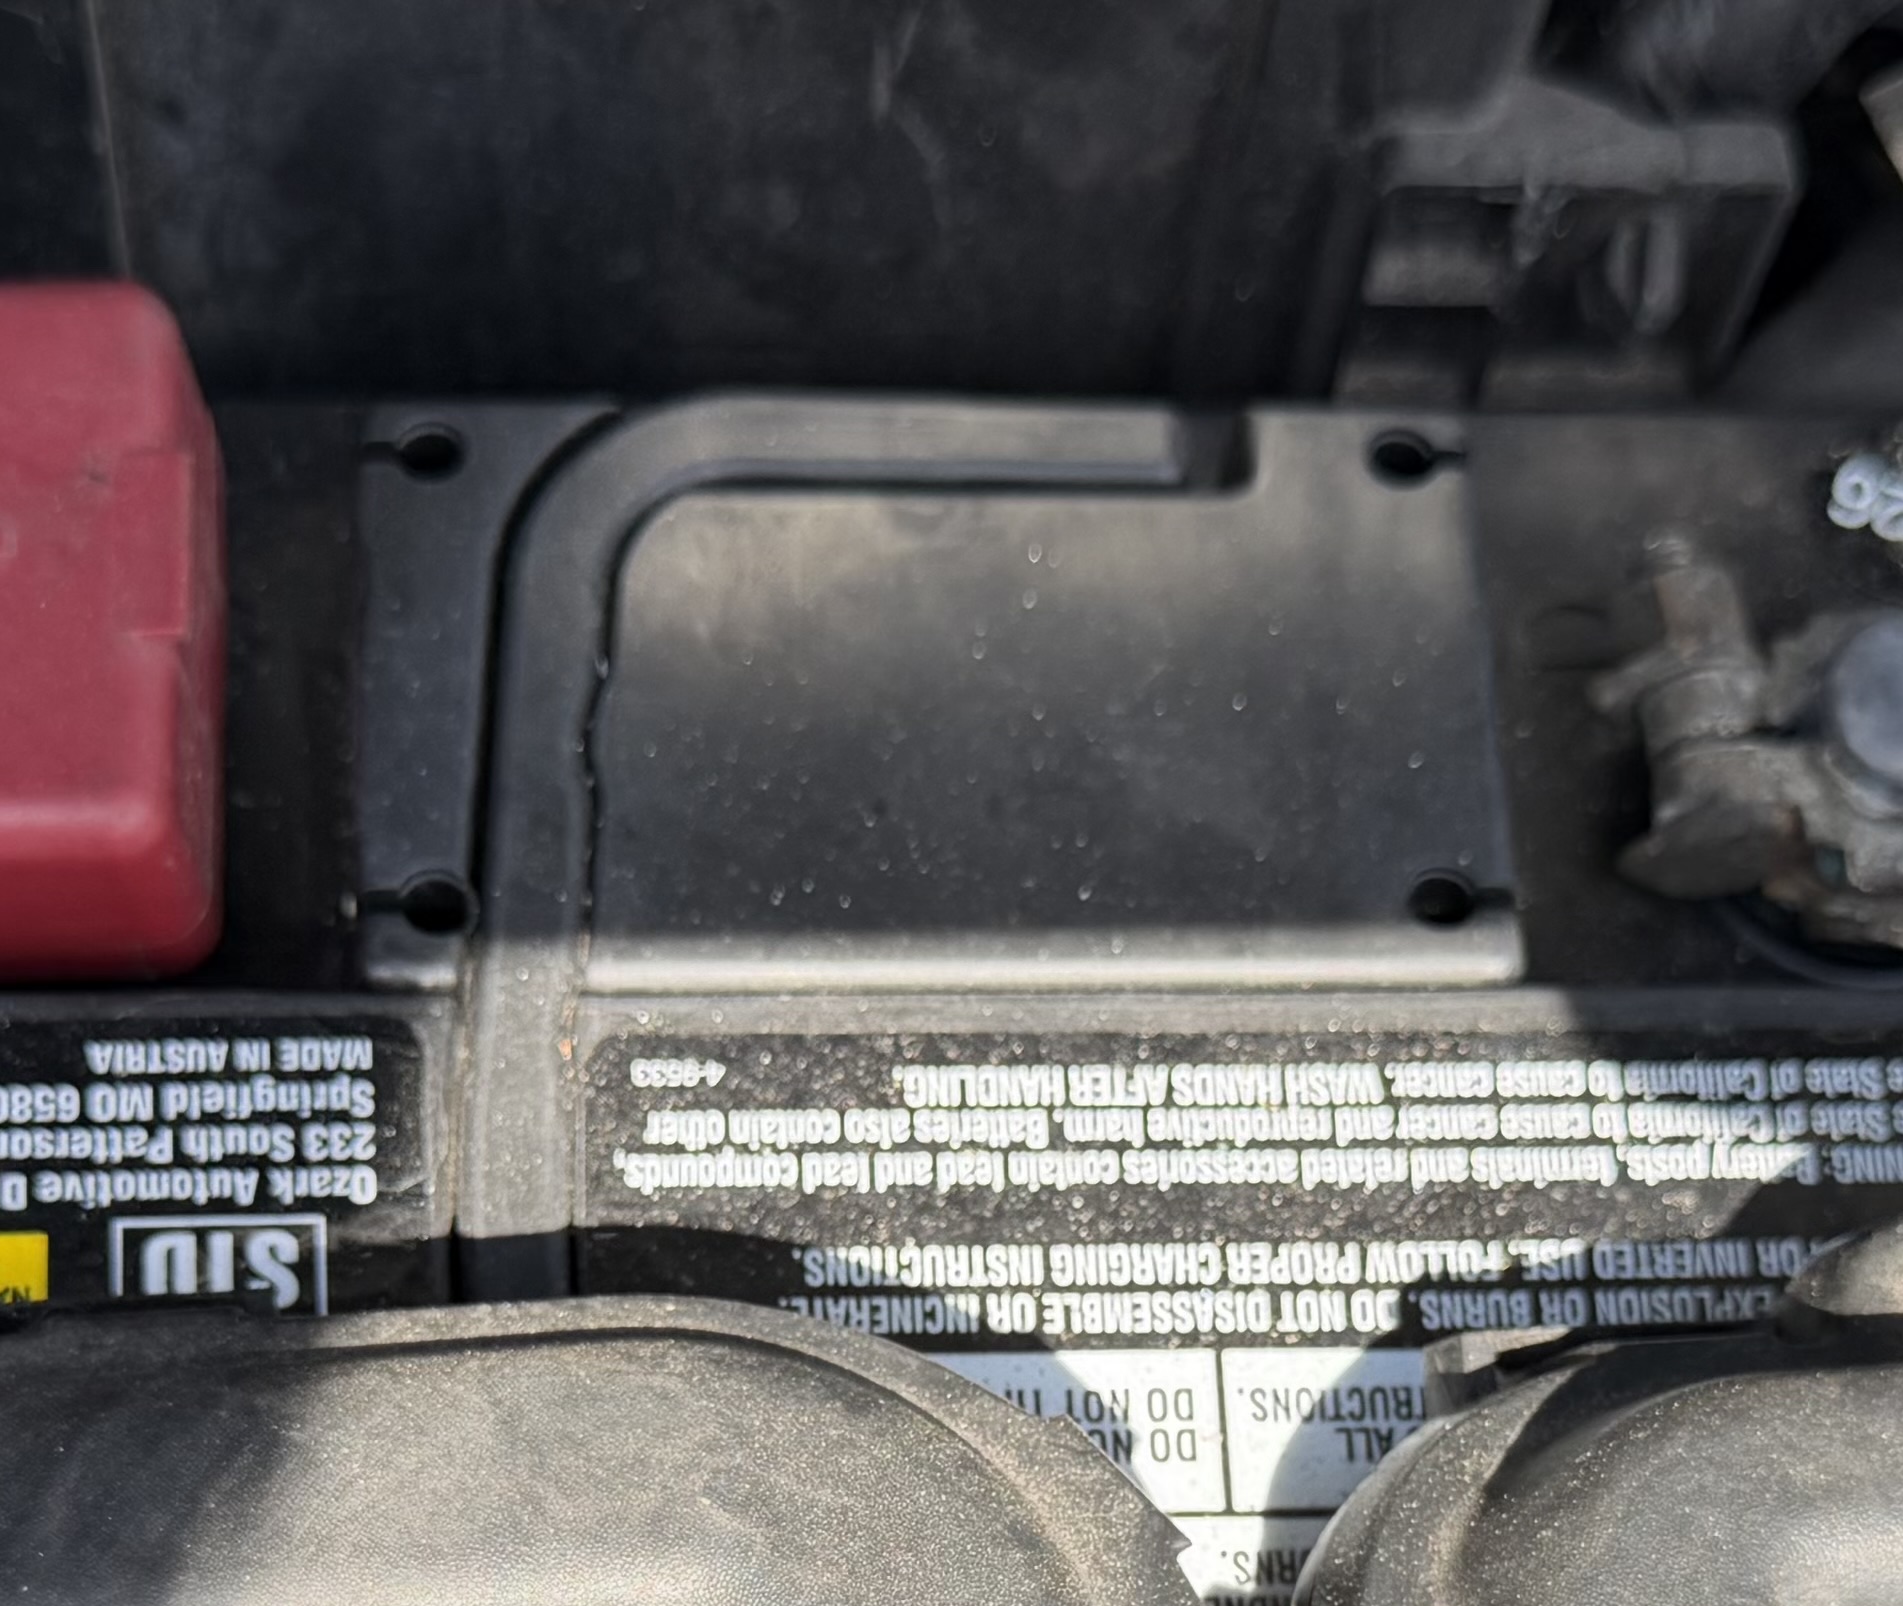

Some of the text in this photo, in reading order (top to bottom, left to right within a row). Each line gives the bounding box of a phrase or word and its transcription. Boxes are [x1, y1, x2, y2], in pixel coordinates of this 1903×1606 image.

[83, 1035, 373, 1074] MADE IN AUSTRIA
[159, 1072, 375, 1120] Springfield
[892, 1064, 1066, 1108] HANDLING.
[1067, 1064, 1169, 1106] AFTER
[1169, 1064, 1283, 1106] HANDS
[1284, 1063, 1384, 1105] WASH
[1496, 1060, 1587, 1098] cause
[1588, 1061, 1624, 1102] to
[1624, 1058, 1770, 1102] California
[1770, 1058, 1804, 1100] of
[1805, 1057, 1886, 1100] State
[86, 1082, 154, 1121] MO
[1395, 1104, 1499, 1140] cancer
[1500, 1103, 1592, 1140] cause
[1775, 1101, 1810, 1142] of
[1811, 1100, 1892, 1143] State
[178, 1124, 295, 1162] South
[304, 1121, 377, 1160] 233
[642, 1109, 726, 1151] other
[728, 1108, 842, 1151] contain
[844, 1109, 911, 1150] also
[913, 1107, 1049, 1150] Batteries
[1052, 1107, 1145, 1149] harm.
[1147, 1104, 1332, 1148] reproductive
[1334, 1105, 1395, 1148] and
[1592, 1103, 1627, 1144] to
[1628, 1102, 1775, 1144] California
[32, 1168, 259, 1208] Automotive
[266, 1165, 377, 1204] Ozark
[613, 1145, 799, 1196] compounds,
[802, 1152, 871, 1195] lead
[874, 1151, 933, 1194] and
[937, 1150, 1004, 1194] lead
[1008, 1147, 1119, 1192] contain
[1122, 1147, 1299, 1192] accessories
[1301, 1147, 1408, 1192] related
[1410, 1146, 1469, 1192] and
[1470, 1145, 1616, 1189] terminals
[791, 1244, 1044, 1287] INSTRUCTIONS.
[1049, 1243, 1221, 1287] CHARGING
[1225, 1241, 1361, 1285] PROPER
[1365, 1239, 1506, 1284] FOLLOW
[1593, 1238, 1751, 1280] INVERTED
[986, 1292, 1037, 1334] OR
[1041, 1289, 1272, 1334] DISASSEMBLE
[1276, 1290, 1347, 1333] NOT
[1350, 1289, 1401, 1333] DO
[1407, 1289, 1533, 1331] BURNS.
[1537, 1290, 1590, 1329] OR
[1066, 1388, 1129, 1426] NOT
[1146, 1387, 1195, 1423] DO
[1148, 1427, 1198, 1463] DO
